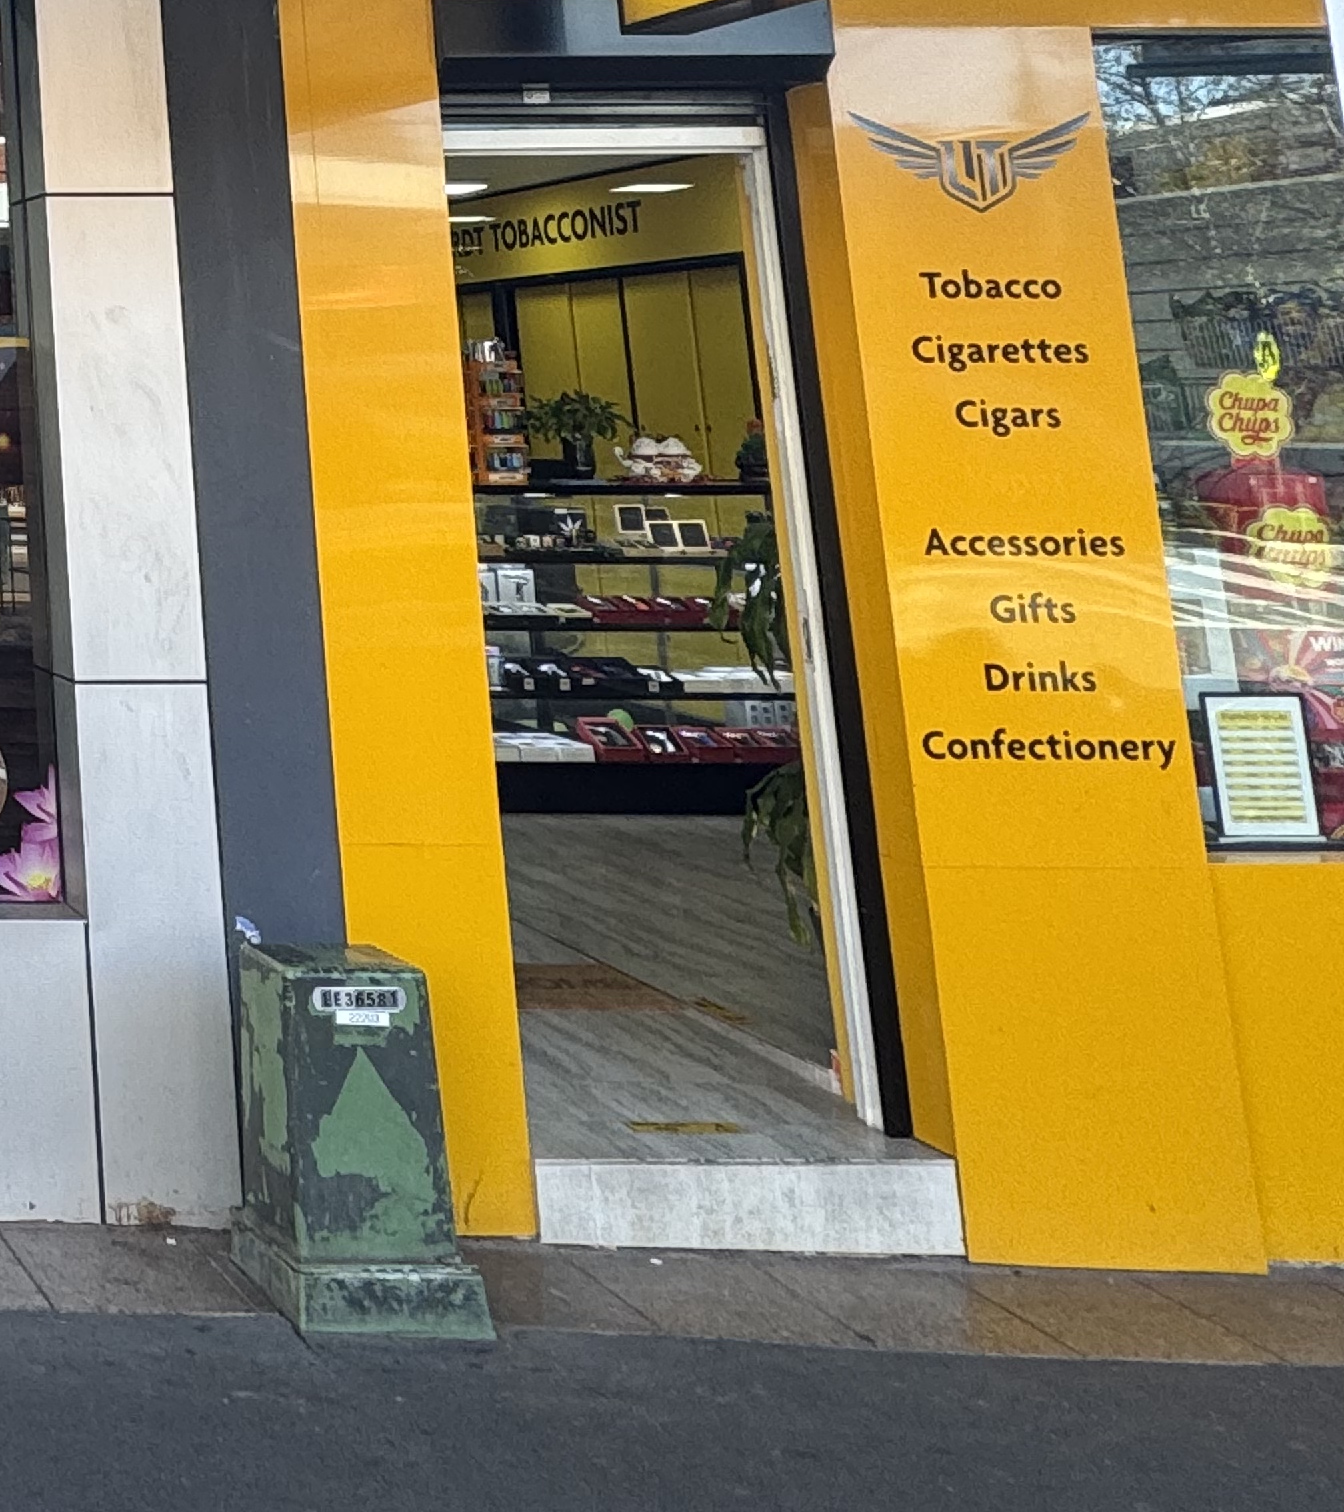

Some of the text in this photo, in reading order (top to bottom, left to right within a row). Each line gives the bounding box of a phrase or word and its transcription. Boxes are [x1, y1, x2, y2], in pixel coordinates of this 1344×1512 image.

[489, 199, 642, 253] TOBACCONIST
[919, 270, 1063, 301] Tobacco
[912, 335, 1090, 371] Cigarettes
[1219, 390, 1280, 413] Chupa
[955, 400, 1062, 438] Cigars
[1218, 411, 1280, 435] Chups
[924, 528, 1125, 560] Accessories
[990, 594, 1077, 625] Gifts
[983, 662, 1097, 695] Drinks
[922, 730, 1177, 769] Confectionery
